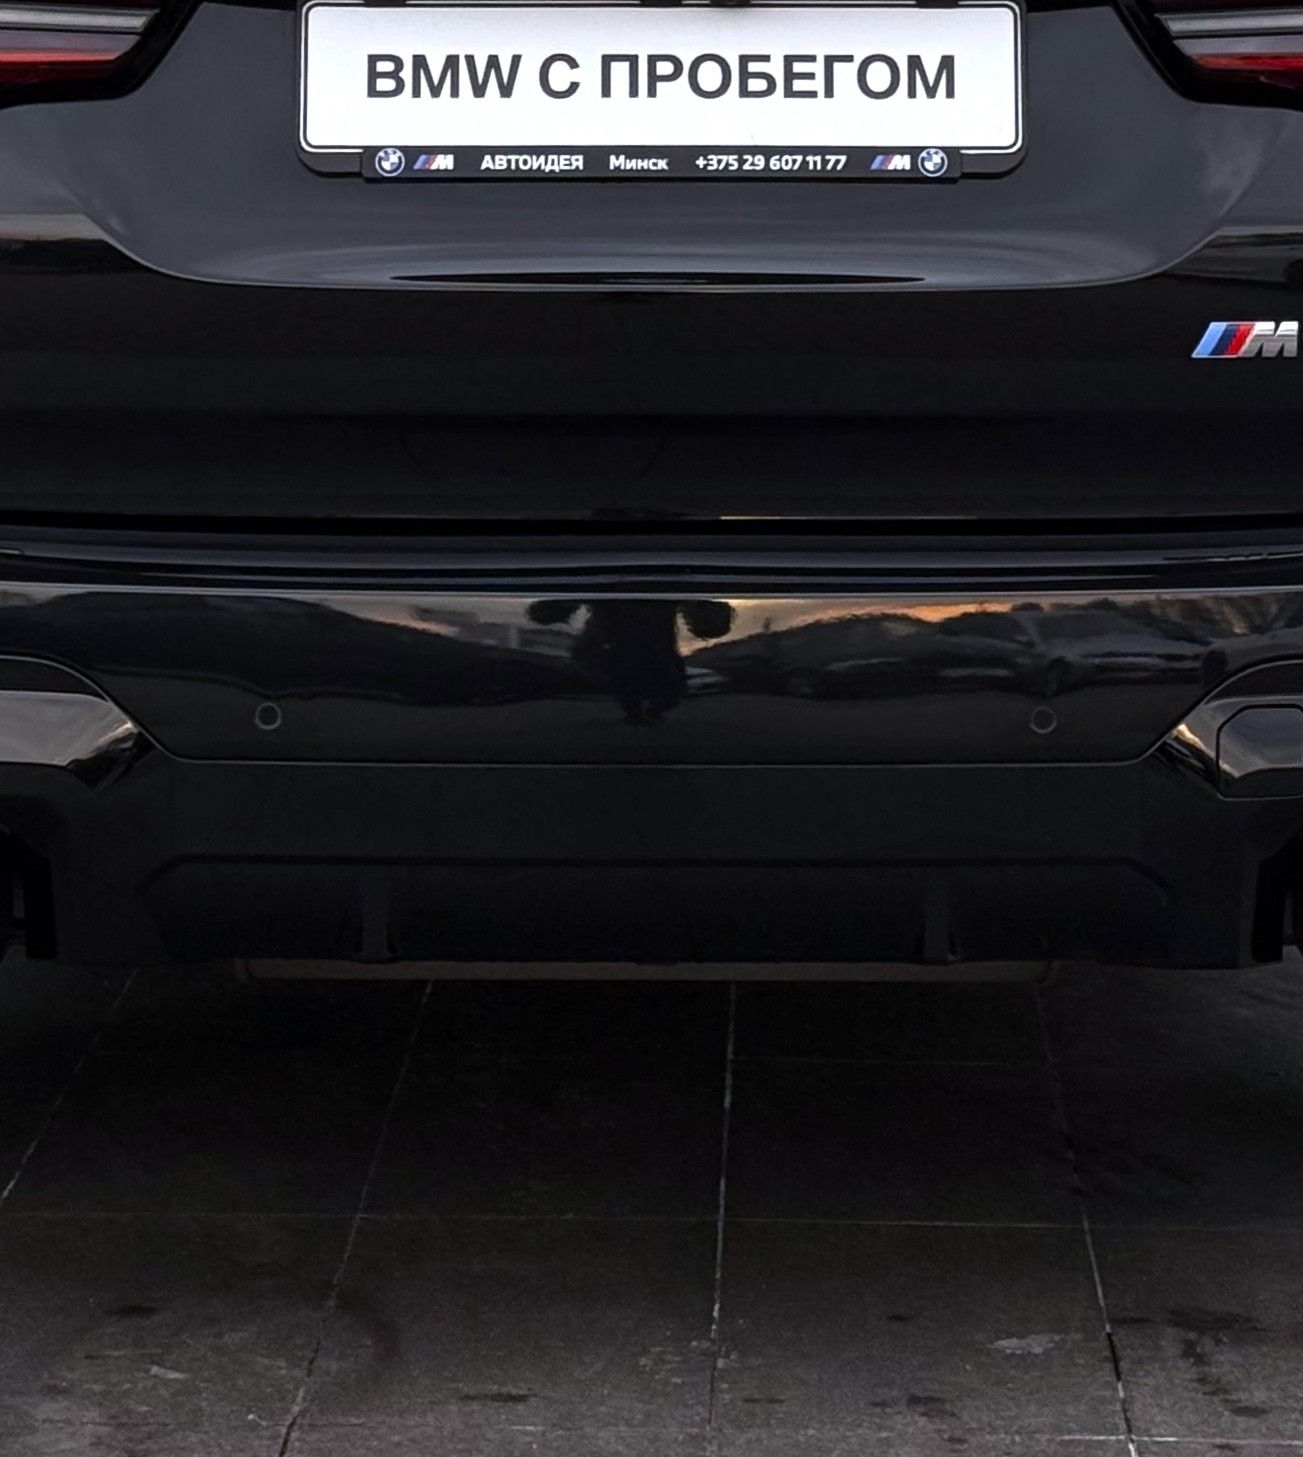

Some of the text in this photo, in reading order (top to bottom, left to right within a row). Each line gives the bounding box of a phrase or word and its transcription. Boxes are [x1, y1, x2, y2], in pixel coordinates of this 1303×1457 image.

[366, 54, 522, 99] BMW
[600, 53, 957, 100] ПРОБЕГОМ
[480, 154, 584, 173] АВТОИДЕЯ
[609, 154, 669, 171] Минск
[695, 154, 739, 171] +375
[742, 154, 765, 171] 29
[769, 154, 803, 171] 607
[806, 154, 823, 171] 11
[825, 154, 847, 171] 77
